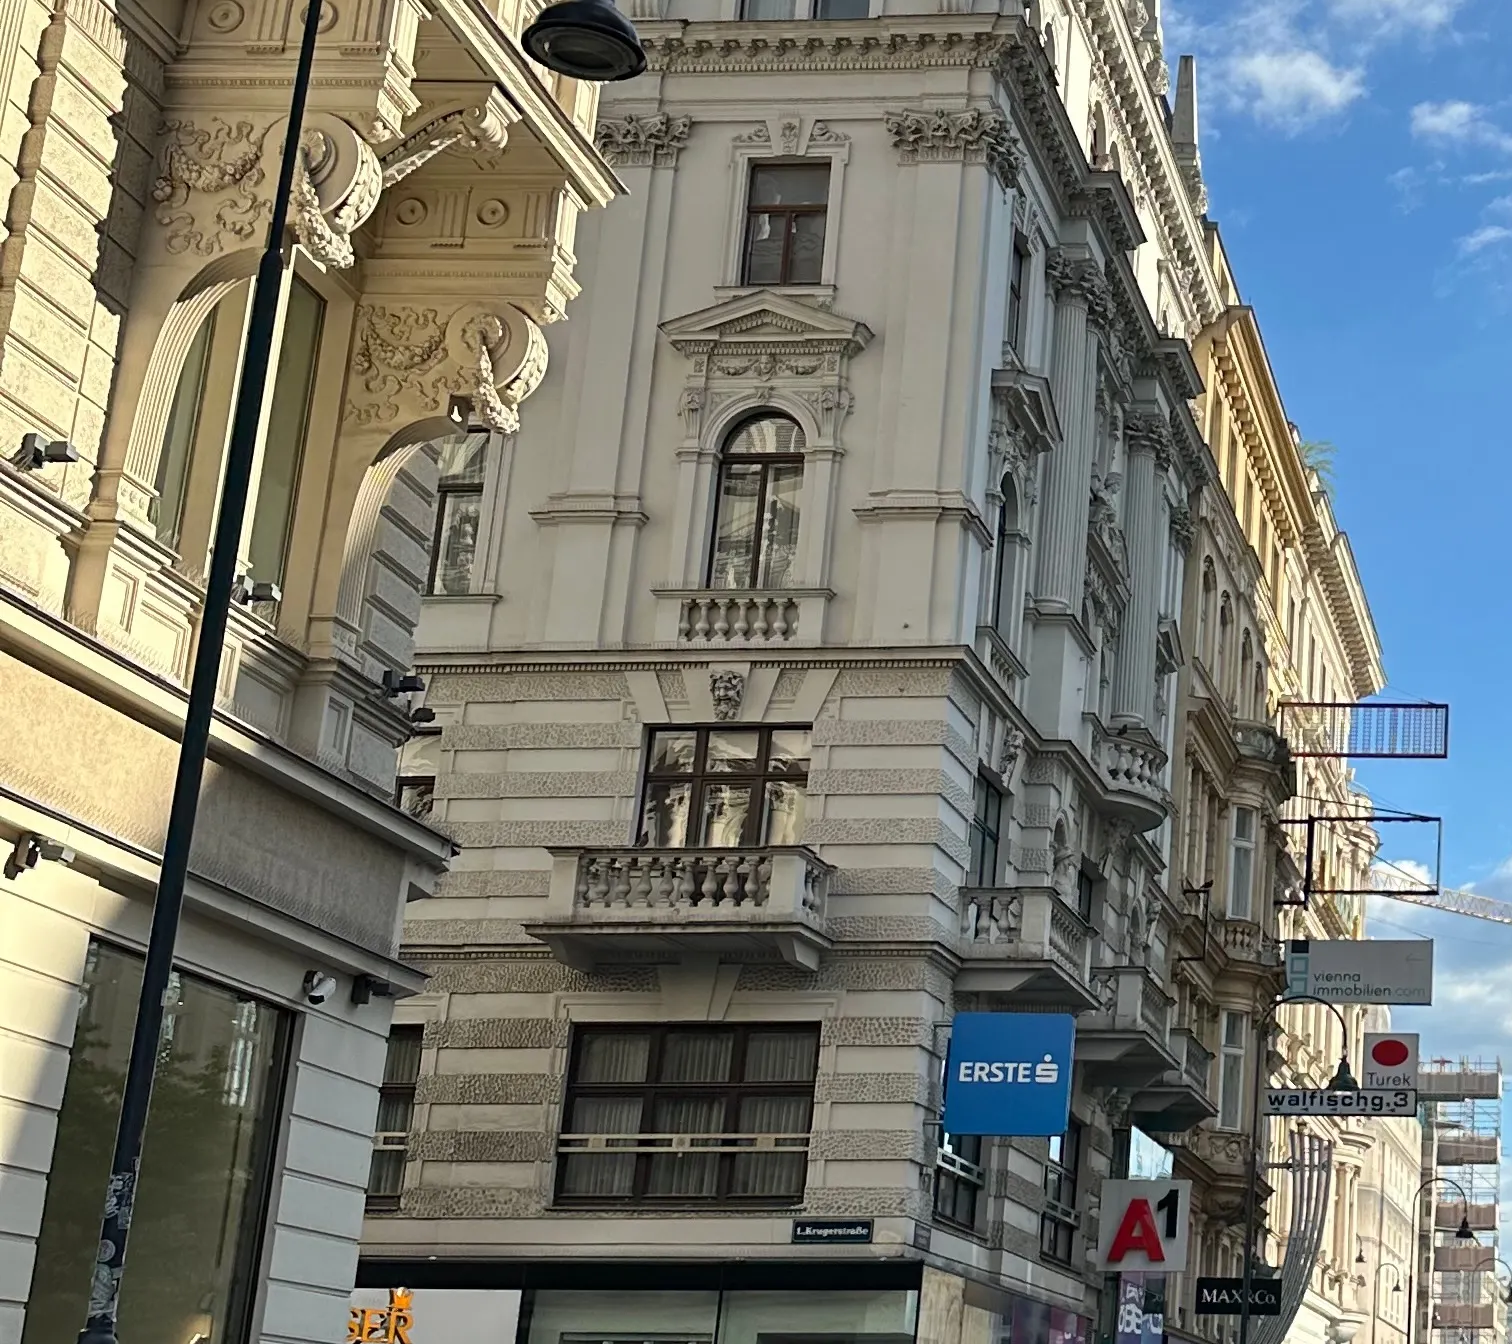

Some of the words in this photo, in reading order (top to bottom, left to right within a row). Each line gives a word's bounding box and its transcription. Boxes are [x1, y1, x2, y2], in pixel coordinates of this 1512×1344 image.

[1313, 972, 1361, 983] vienna
[959, 1061, 1033, 1084] ERSTE
[1366, 1071, 1412, 1087] Turek
[1267, 1090, 1409, 1112] walfischg.3
[1106, 1189, 1180, 1263] A1
